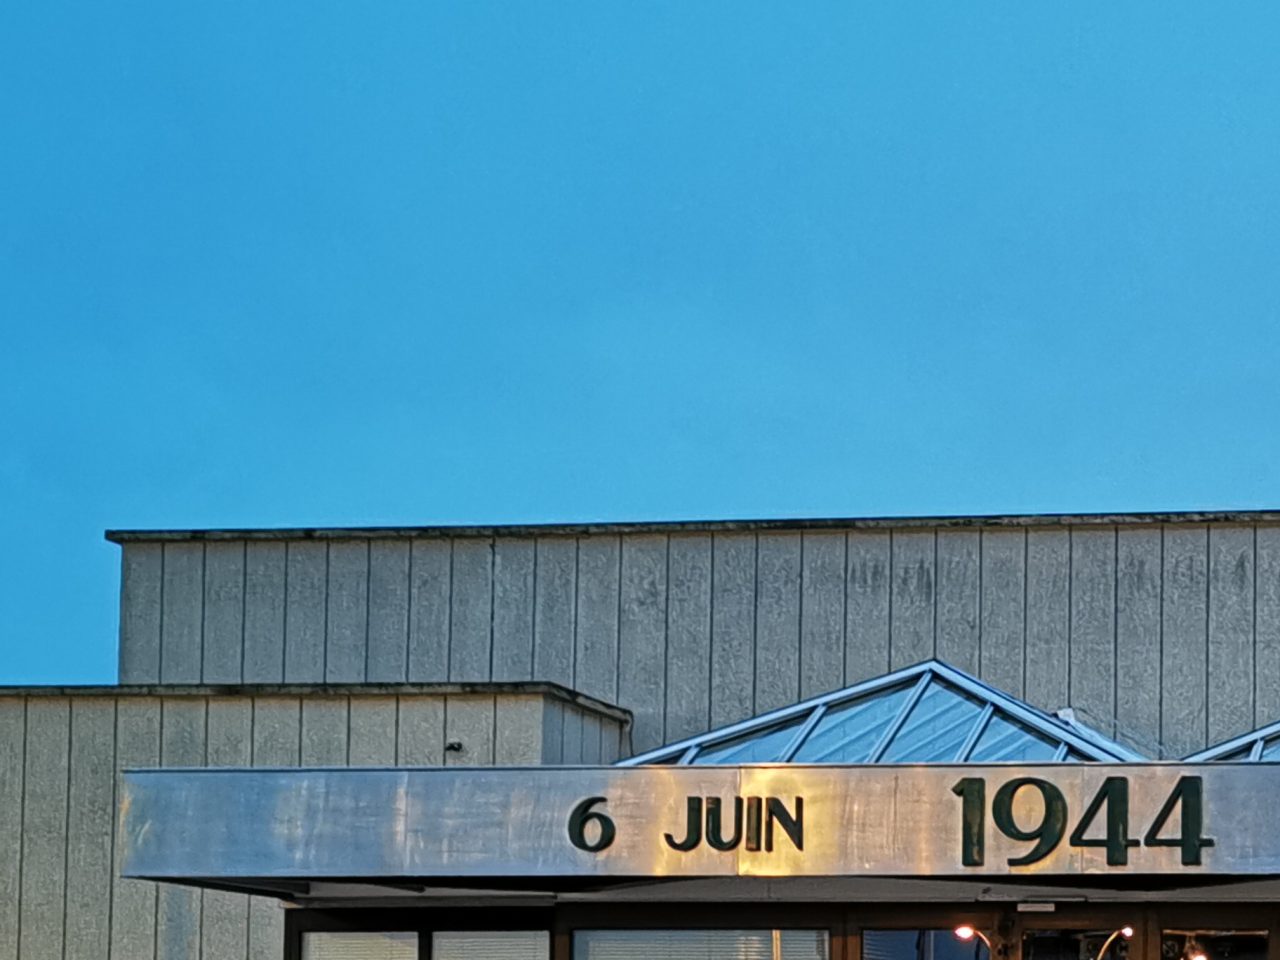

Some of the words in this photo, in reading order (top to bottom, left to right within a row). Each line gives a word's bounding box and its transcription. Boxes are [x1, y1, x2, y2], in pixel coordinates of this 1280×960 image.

[567, 796, 616, 853] 6
[664, 795, 804, 853] JUIN
[951, 775, 1215, 867] 1944
